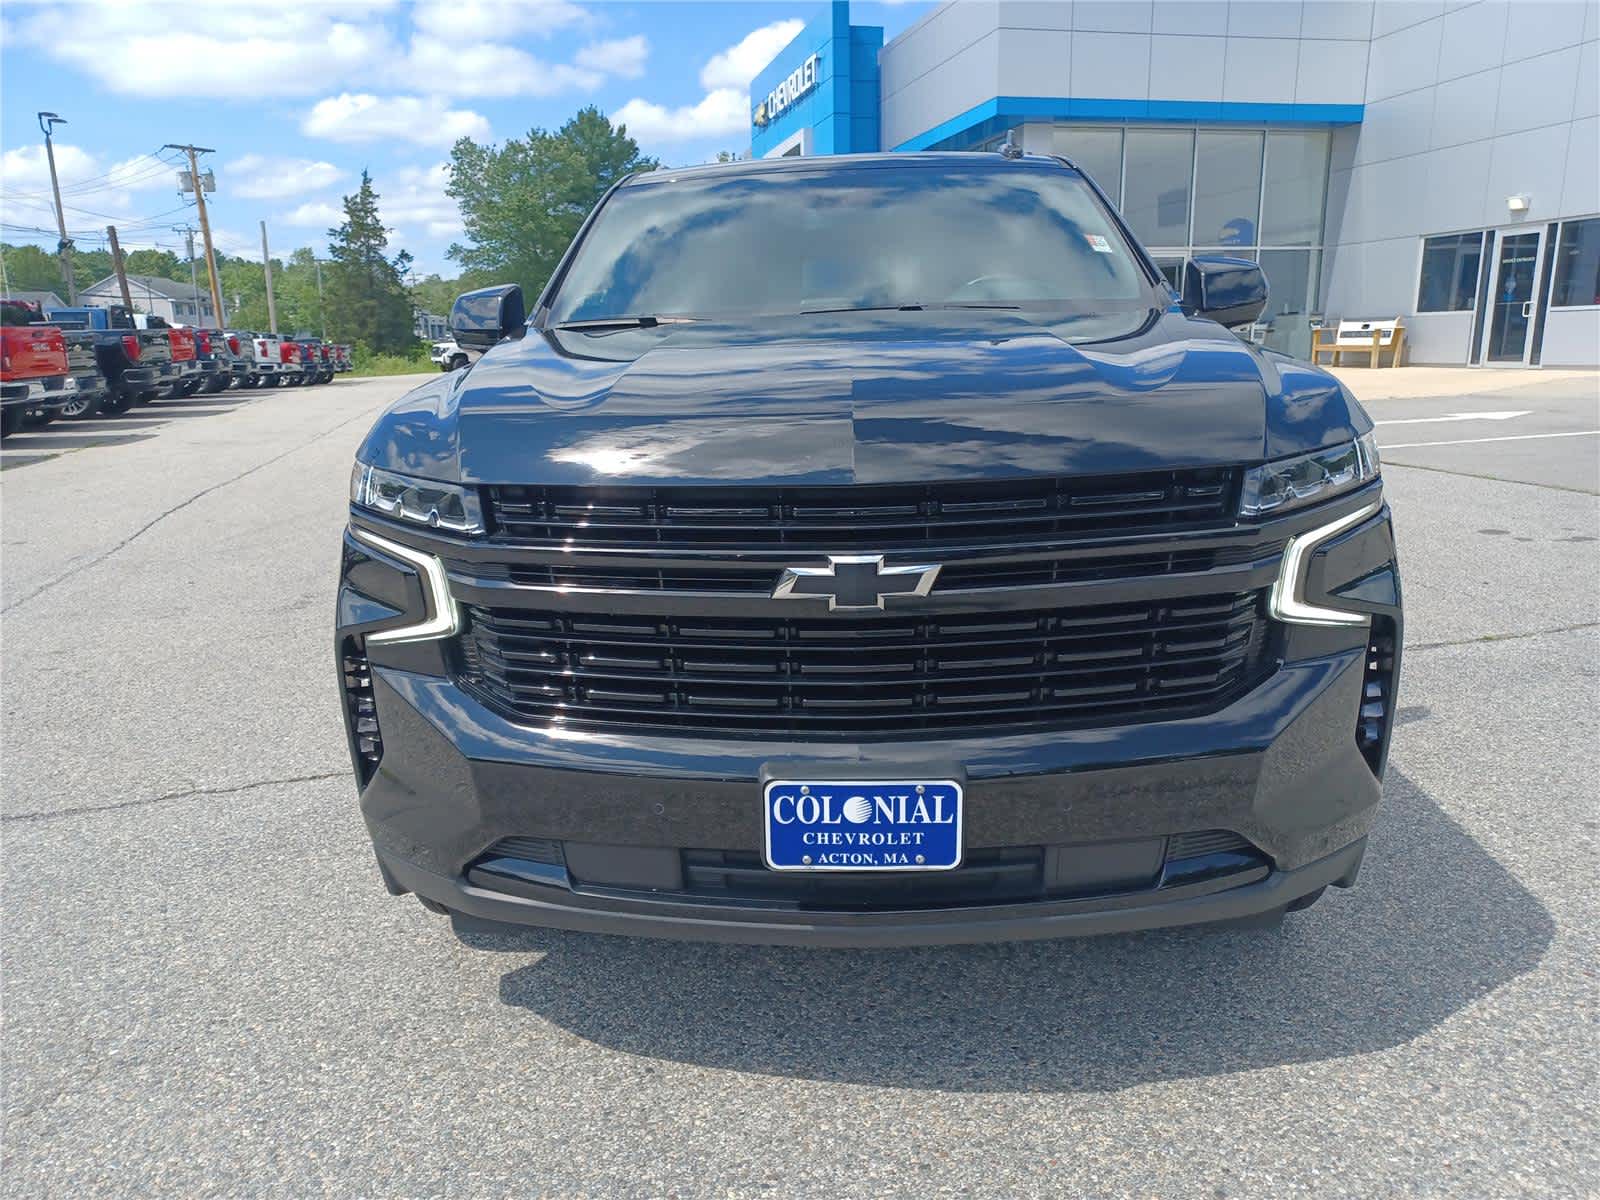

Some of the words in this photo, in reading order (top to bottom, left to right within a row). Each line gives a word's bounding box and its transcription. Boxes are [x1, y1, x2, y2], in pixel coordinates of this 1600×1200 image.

[767, 53, 818, 119] CHEVROLET
[773, 795, 953, 825] COLONIAL
[802, 832, 925, 846] CHEVROLET
[818, 853, 878, 866] ACTON,
[884, 853, 909, 865] MA
